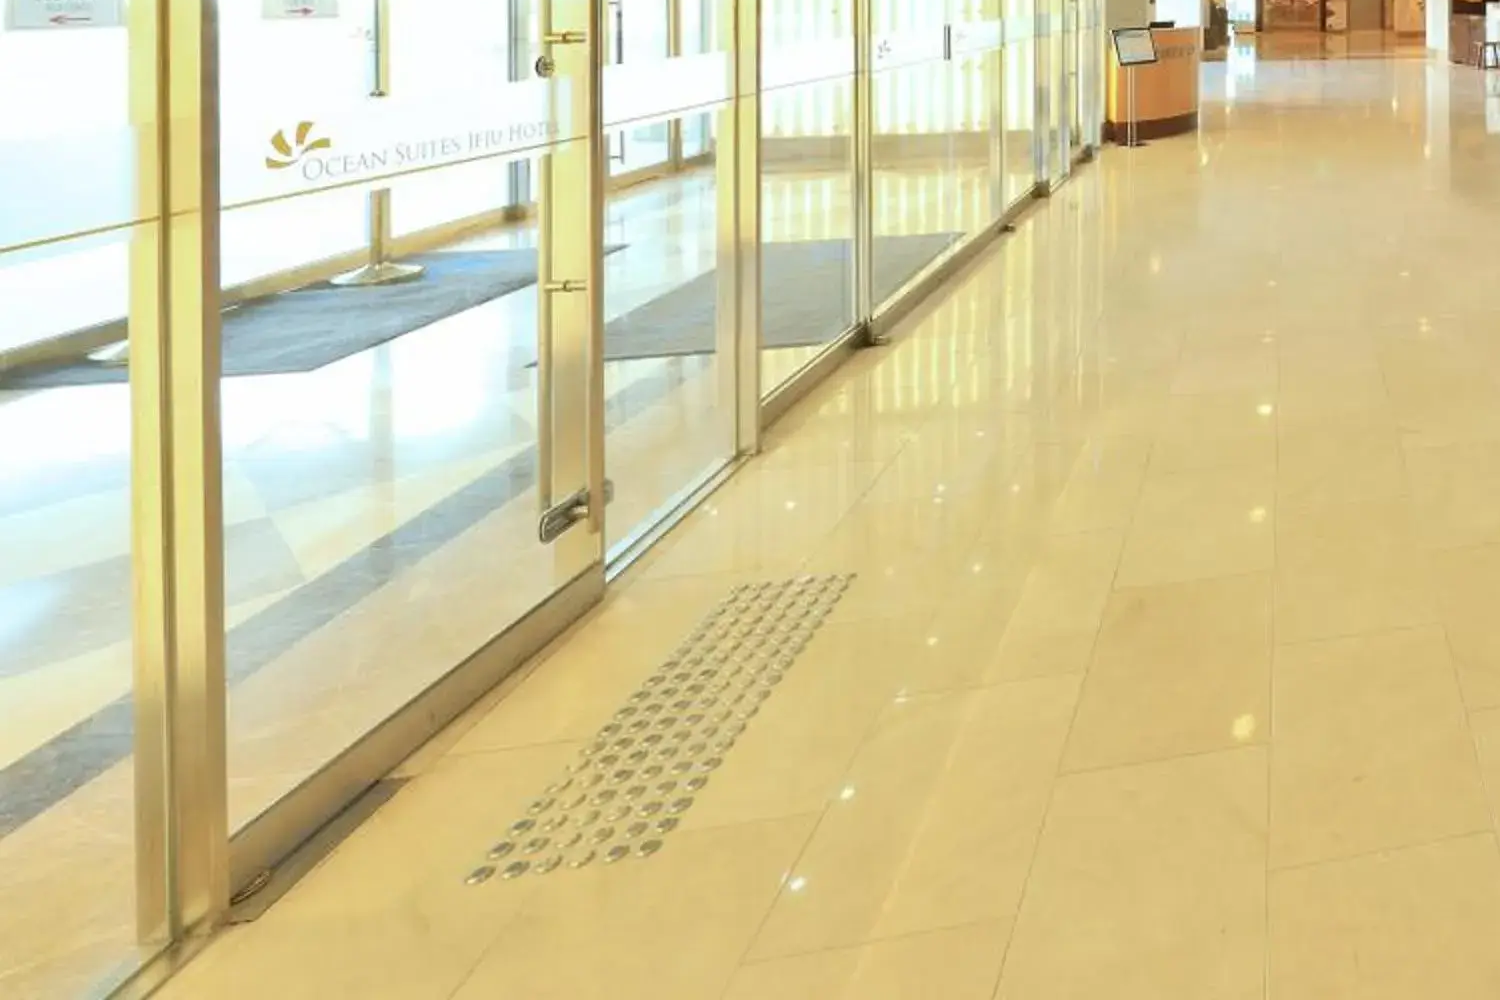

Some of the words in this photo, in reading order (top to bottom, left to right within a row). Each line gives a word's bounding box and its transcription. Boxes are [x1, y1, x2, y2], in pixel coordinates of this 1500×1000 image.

[302, 148, 388, 181] OCEAN
[395, 136, 461, 166] SUITES
[468, 129, 503, 152] JEJU
